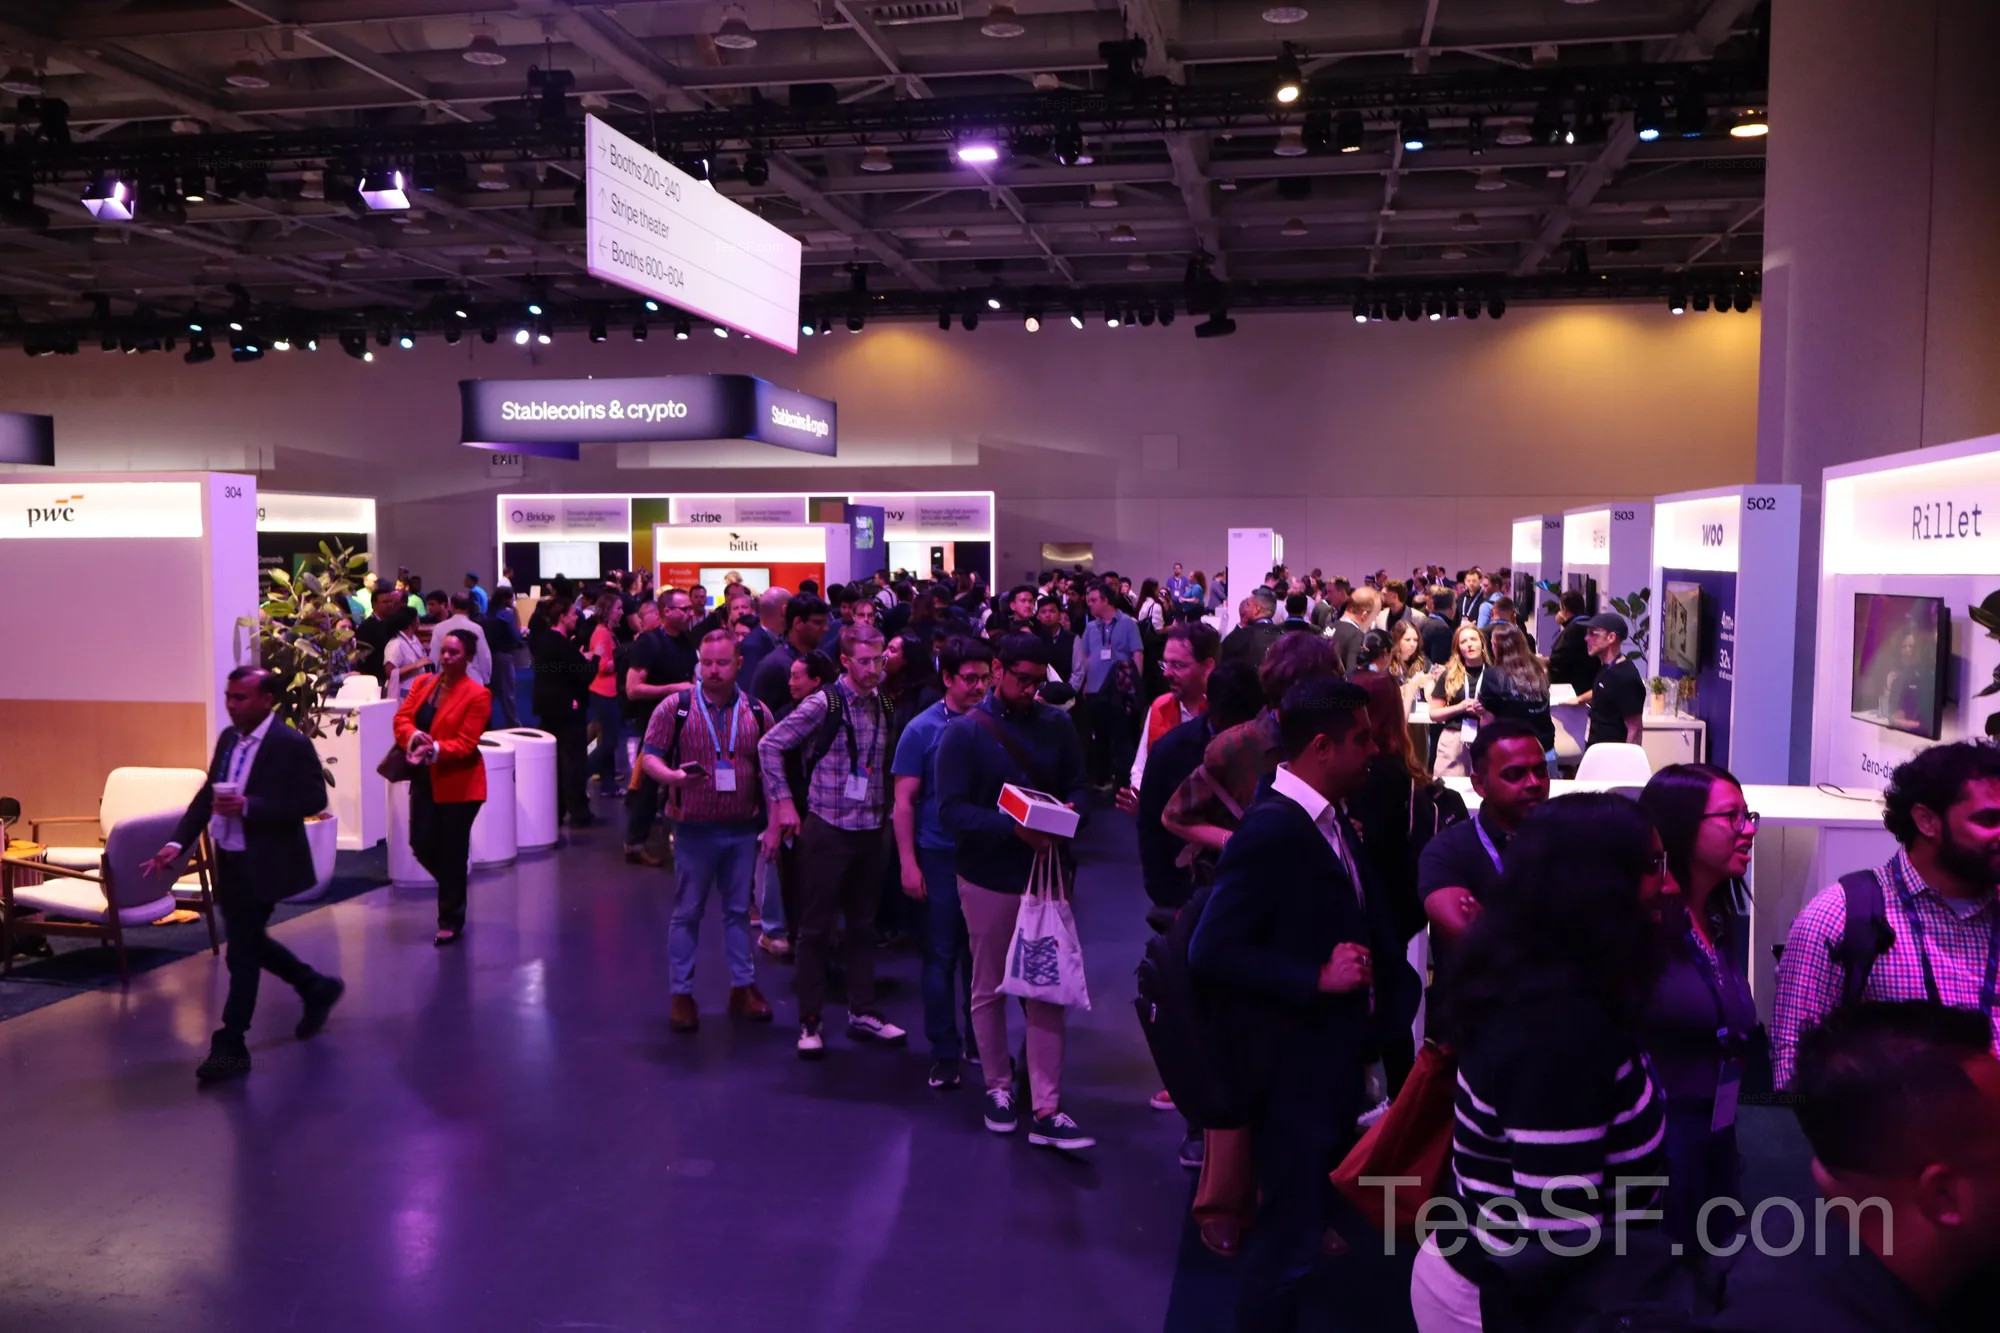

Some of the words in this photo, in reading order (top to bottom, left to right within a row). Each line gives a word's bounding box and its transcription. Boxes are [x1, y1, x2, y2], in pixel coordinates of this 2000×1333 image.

[610, 144, 642, 174] Booths
[611, 194, 638, 230] Stripe
[639, 209, 669, 239] theater
[611, 241, 644, 274] Booths
[501, 401, 605, 421] Stablecoins
[608, 401, 625, 421] &
[627, 401, 688, 423] crypto
[771, 404, 806, 430] Stablecoins
[811, 419, 829, 437] crypto
[492, 454, 520, 466] EXIT
[224, 486, 242, 499] 304
[1746, 497, 1777, 511] 502
[26, 507, 76, 528] pwc
[526, 512, 556, 524] Bridge
[690, 512, 722, 523] stripe
[883, 511, 905, 521] ivy
[1614, 511, 1635, 521] 503
[1911, 501, 1983, 541] Rillet
[1544, 521, 1561, 529] 504
[729, 541, 758, 552] billit
[1861, 752, 1895, 780] Zero-da
